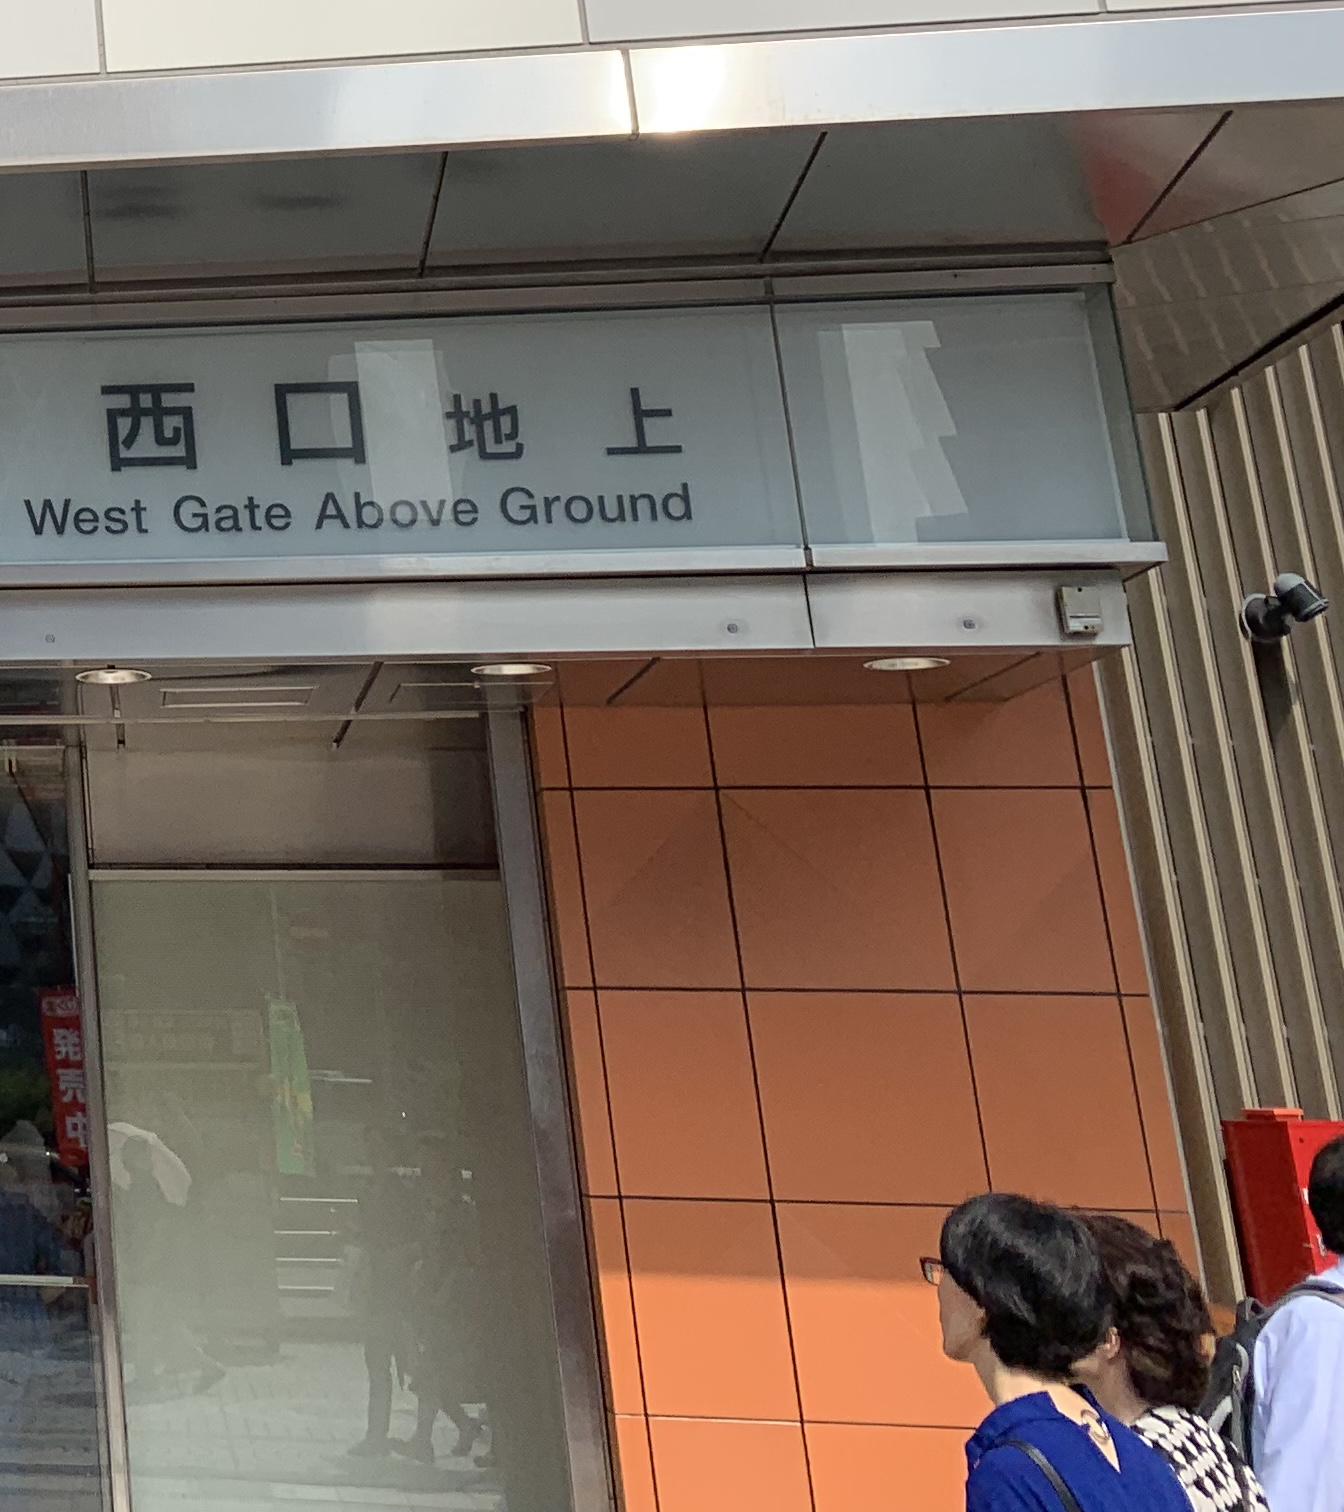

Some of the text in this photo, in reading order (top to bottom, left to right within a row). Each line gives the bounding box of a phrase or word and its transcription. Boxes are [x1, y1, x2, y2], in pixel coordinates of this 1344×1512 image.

[23, 497, 148, 536] West
[172, 494, 293, 534] Gate
[314, 490, 480, 531] Above
[499, 482, 694, 528] Ground
